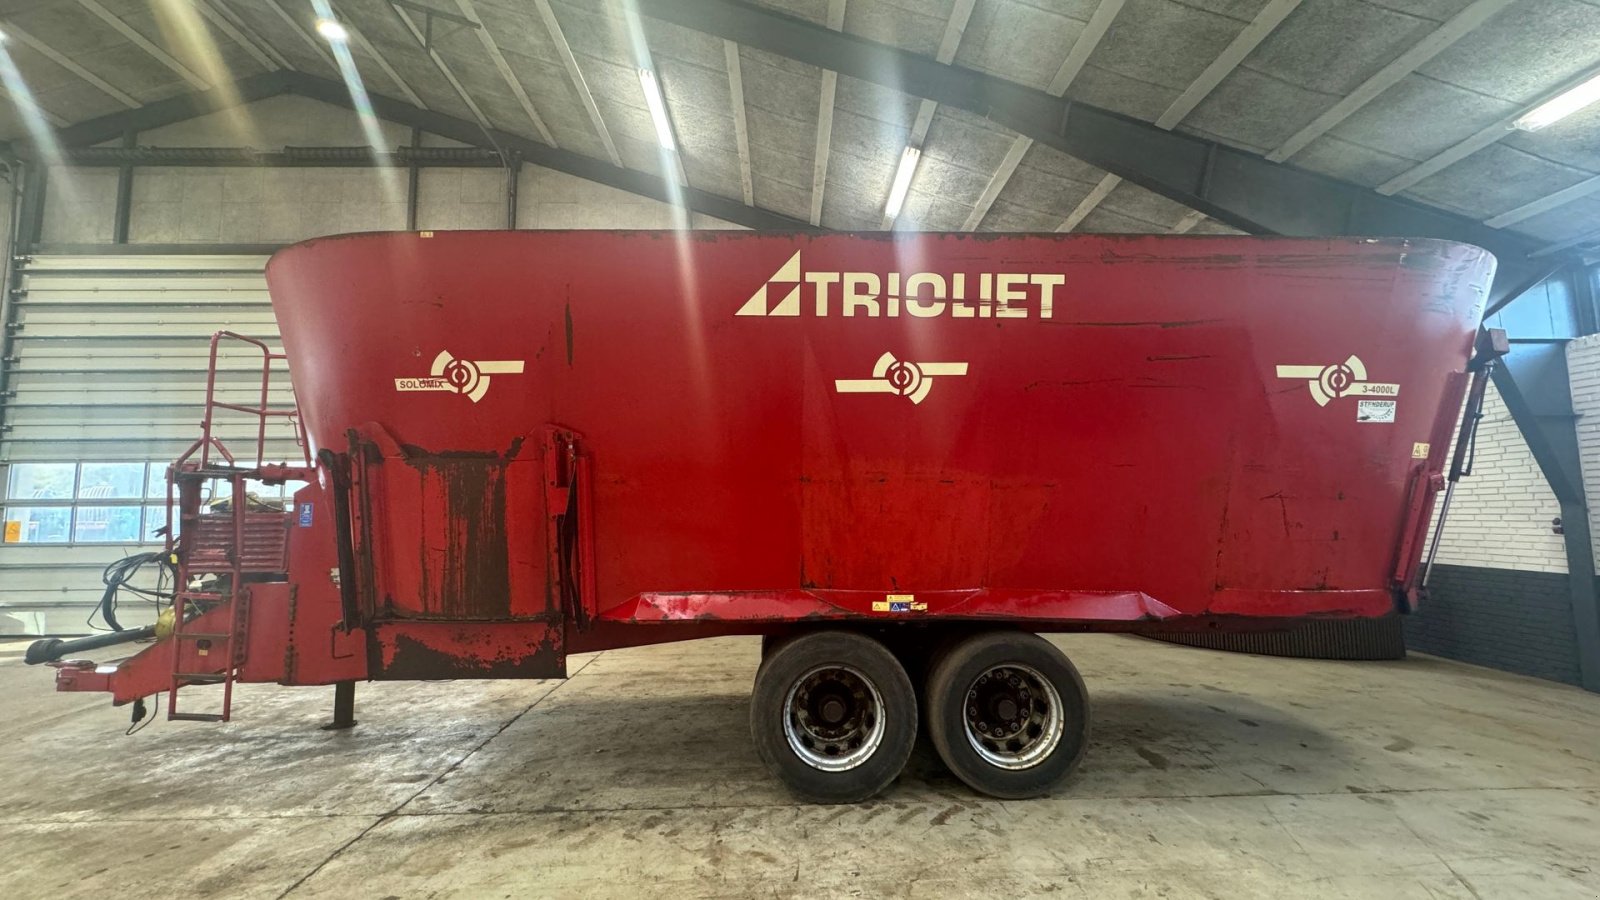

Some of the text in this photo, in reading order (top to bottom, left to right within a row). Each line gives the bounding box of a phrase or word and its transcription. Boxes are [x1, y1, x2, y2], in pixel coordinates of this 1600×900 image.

[804, 272, 1066, 318] TRIOLIET
[399, 380, 444, 390] SOLOMIX
[1362, 384, 1396, 395] 3-4000L
